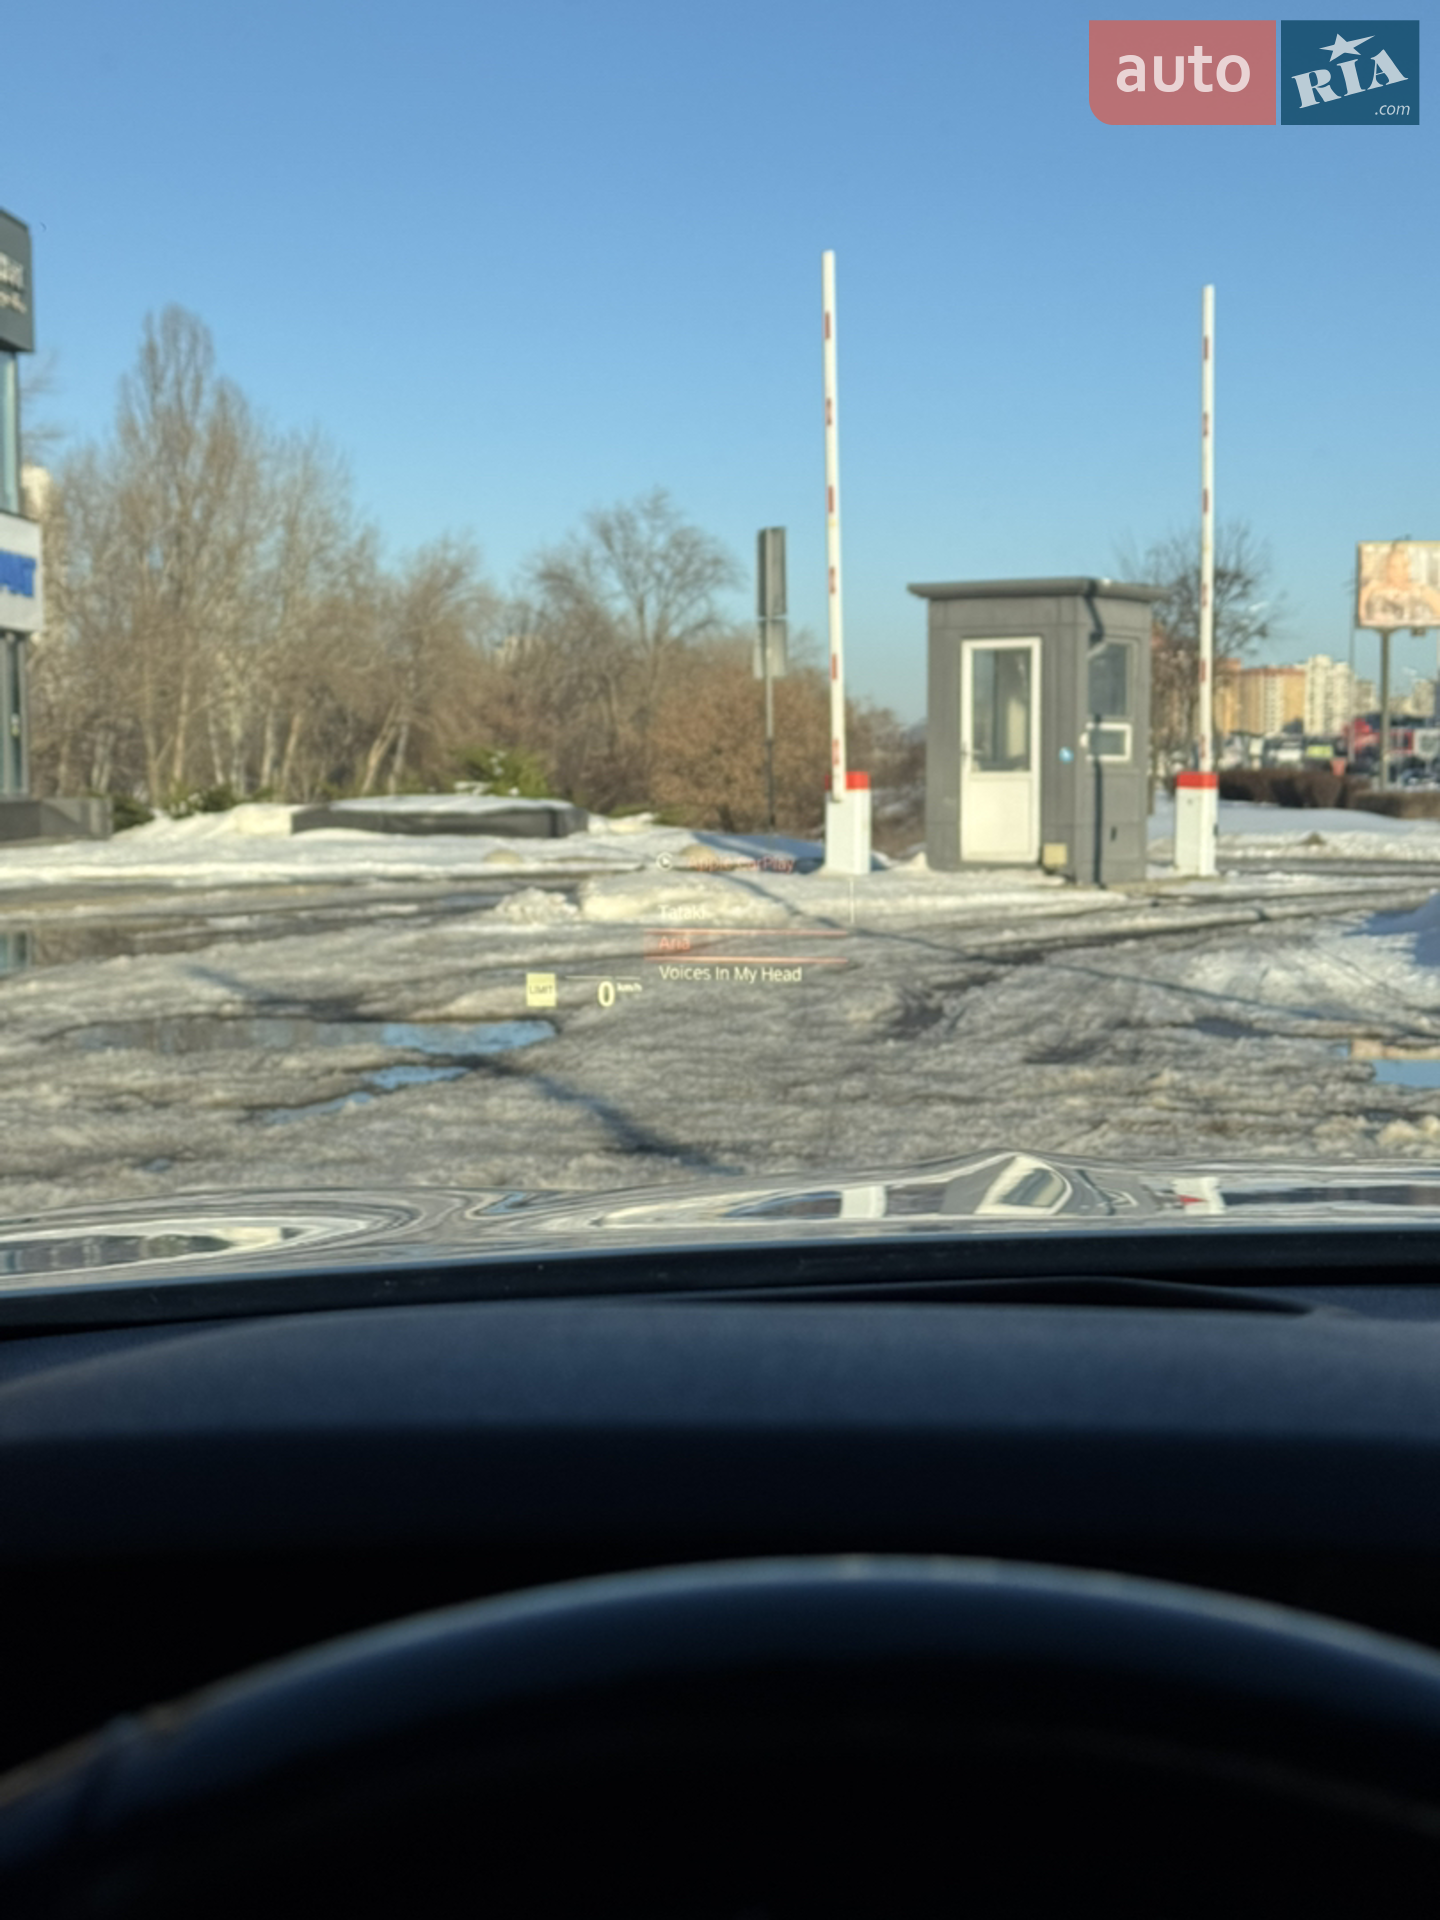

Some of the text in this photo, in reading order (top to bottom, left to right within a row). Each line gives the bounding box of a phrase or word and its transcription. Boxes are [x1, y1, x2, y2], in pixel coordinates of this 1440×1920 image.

[659, 965, 802, 984] Voices In My Head
[598, 981, 615, 1007] 0
